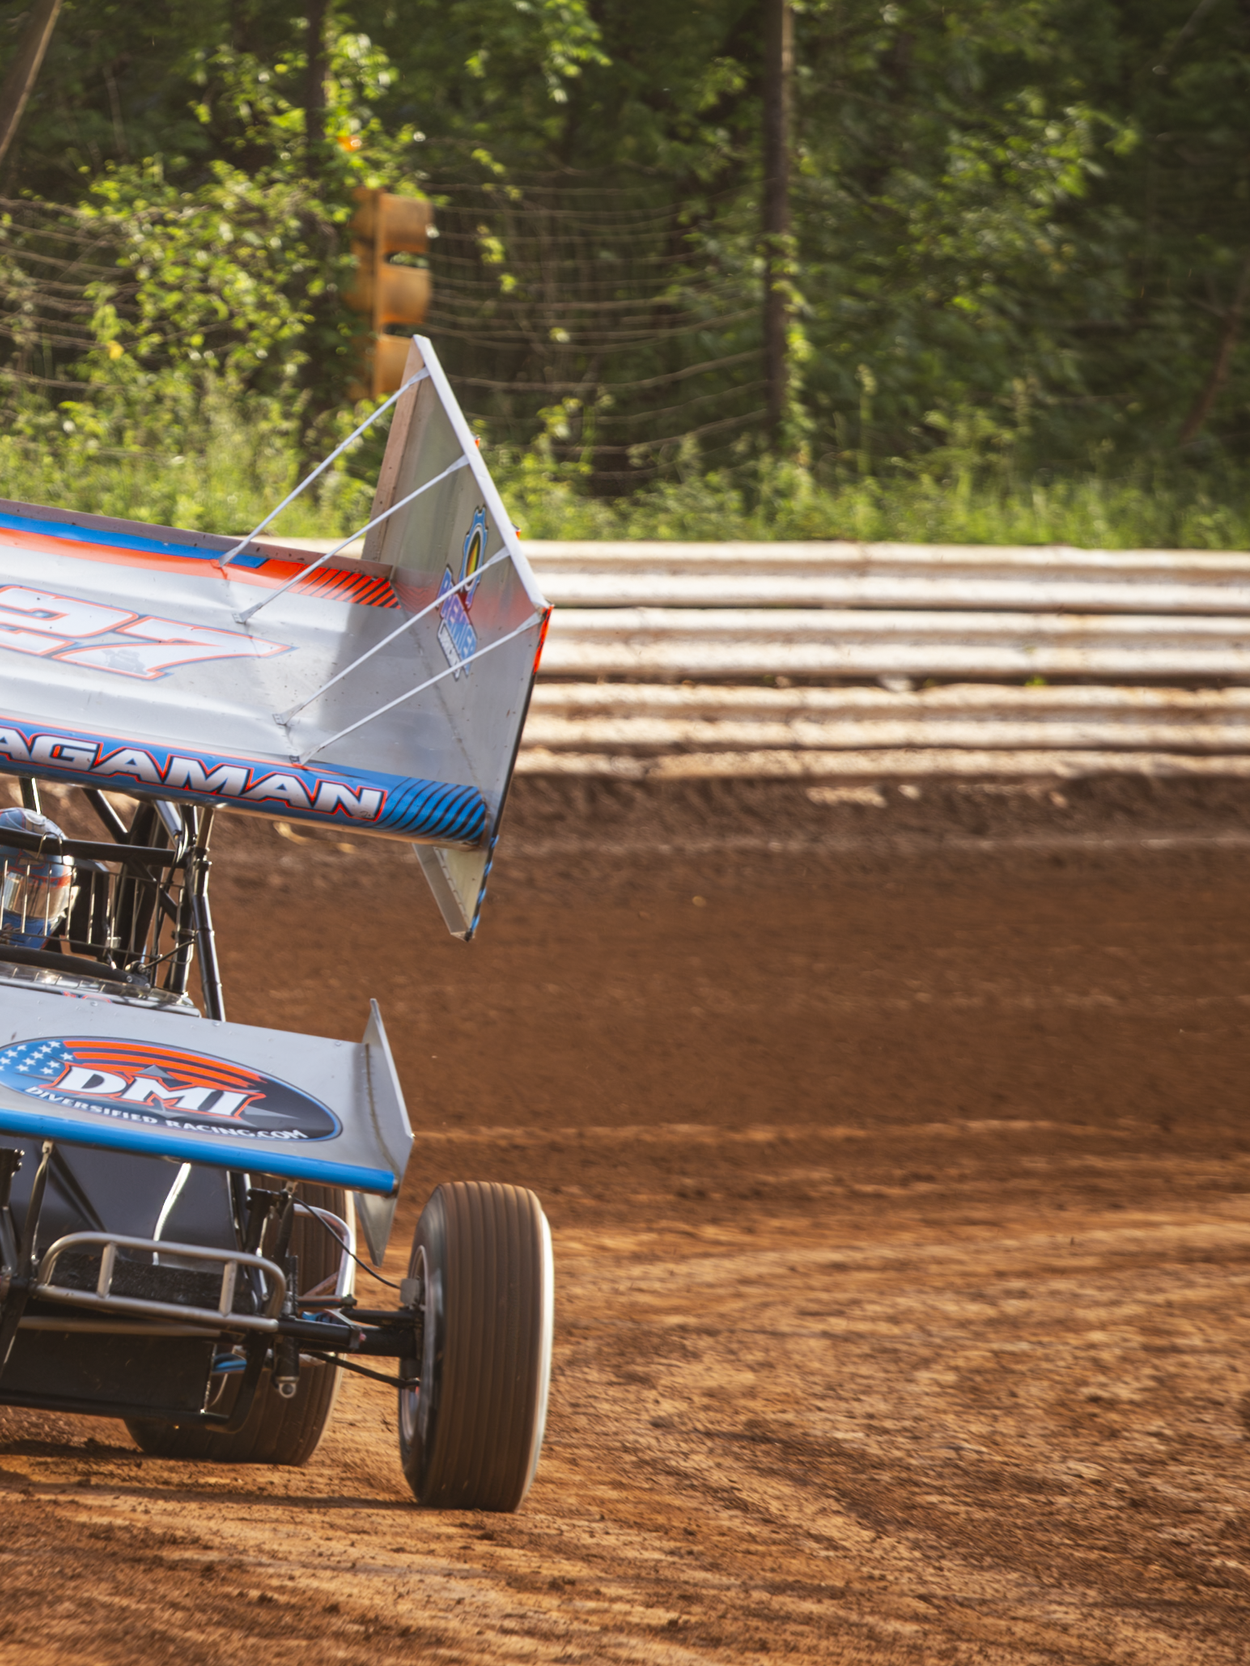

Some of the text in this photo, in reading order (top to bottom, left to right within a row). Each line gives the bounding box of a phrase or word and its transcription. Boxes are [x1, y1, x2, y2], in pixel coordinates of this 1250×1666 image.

[25, 1086, 309, 1140] DIVERSIFIED RACING.COM
[54, 1066, 251, 1117] DMI
